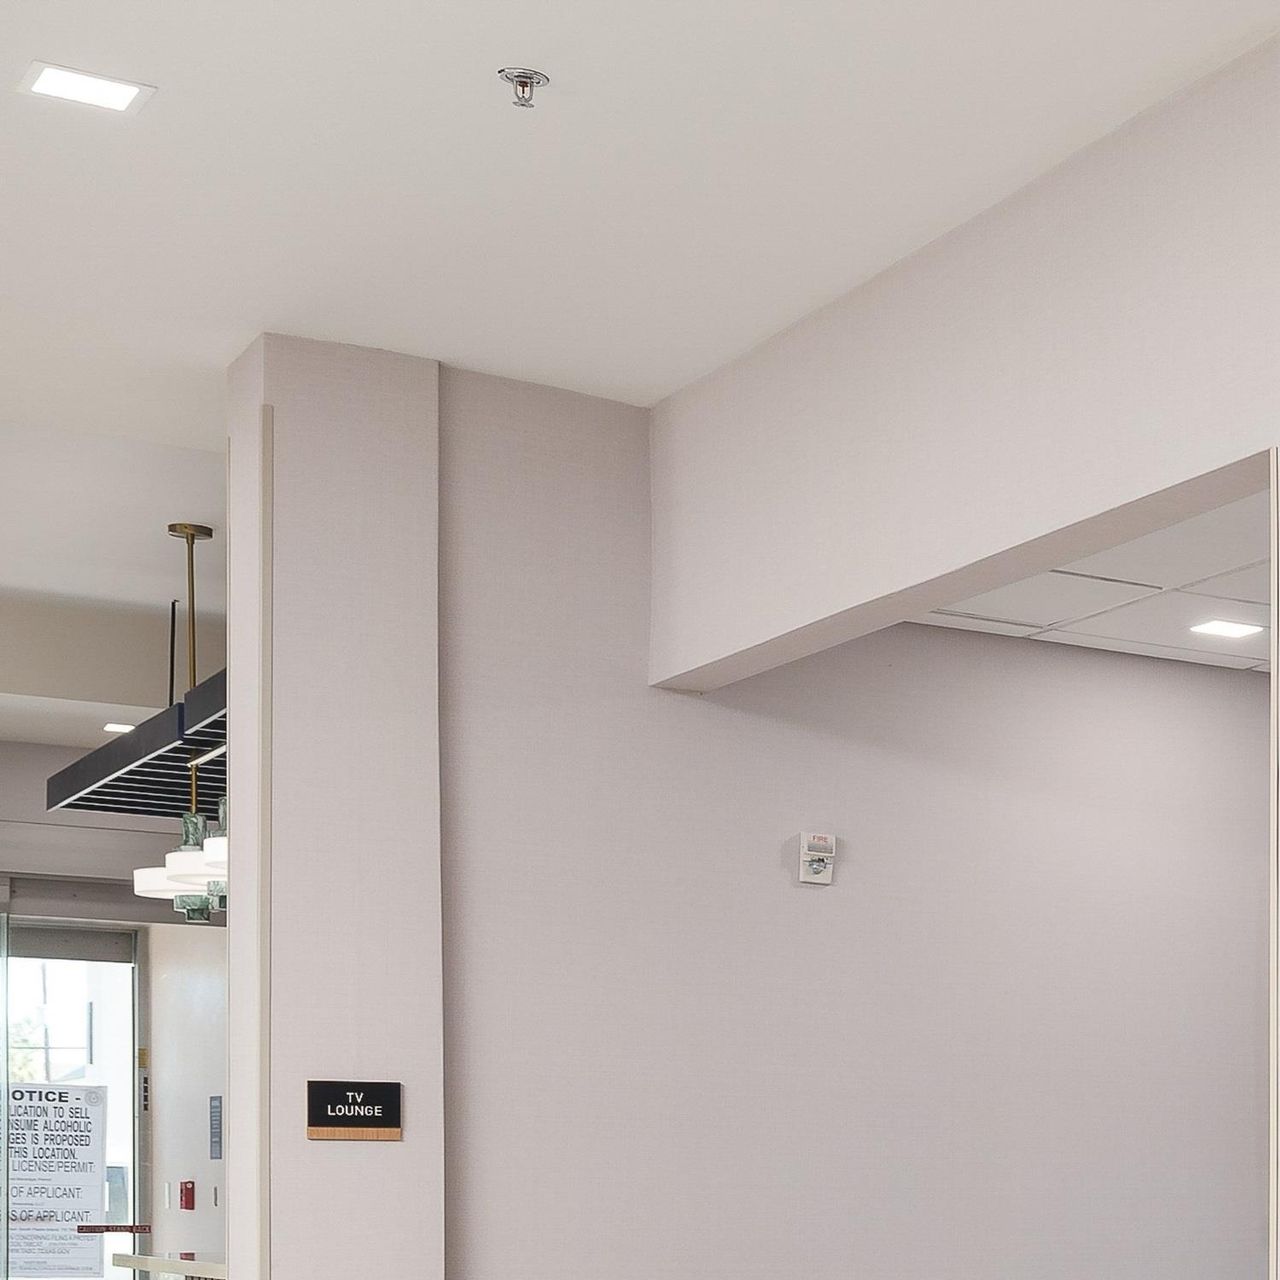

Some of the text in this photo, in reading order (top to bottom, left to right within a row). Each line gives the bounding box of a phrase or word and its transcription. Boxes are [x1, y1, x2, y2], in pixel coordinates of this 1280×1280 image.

[11, 1090, 70, 1103] OTICE
[346, 1092, 364, 1103] TV
[9, 1105, 90, 1119] LICATION TO SELL
[327, 1104, 383, 1116] LOUNGE
[9, 1119, 92, 1133] NSUME ALCOHOLIC
[31, 1133, 39, 1145] IS
[43, 1133, 91, 1146] PROPOSED
[11, 1186, 24, 1198] OF
[20, 1210, 34, 1221] OF
